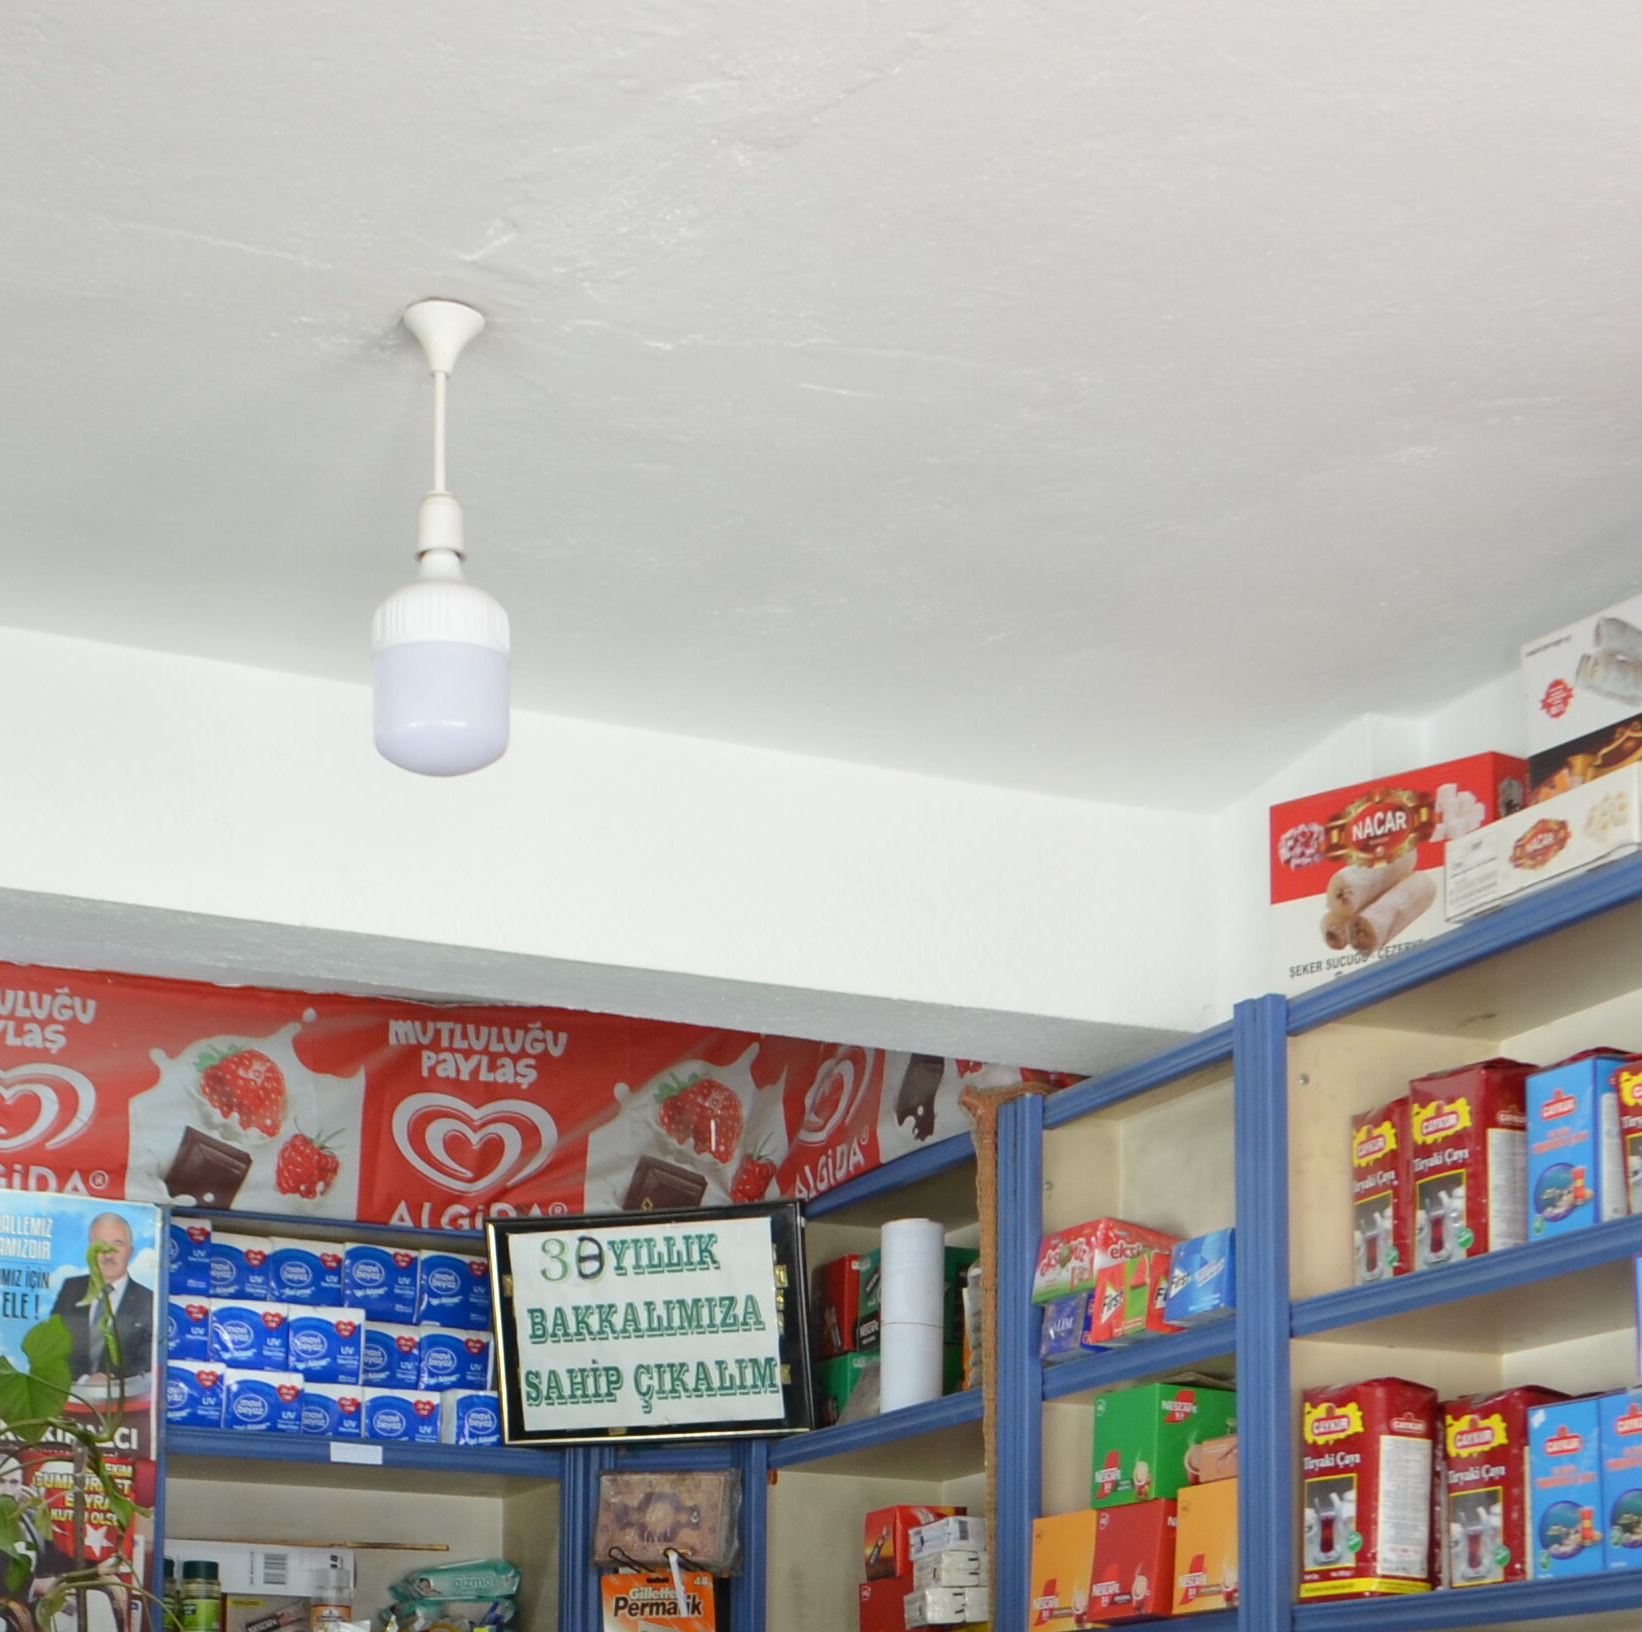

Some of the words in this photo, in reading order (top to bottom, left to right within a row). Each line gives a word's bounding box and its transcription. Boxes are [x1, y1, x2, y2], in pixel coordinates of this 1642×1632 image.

[1352, 809, 1408, 843] NACAR
[2, 1291, 28, 1319] ELE
[526, 1294, 766, 1345] BAKKALIMIZA
[523, 1358, 627, 1408] SAHİP
[635, 1357, 782, 1415] ÇIKALIM
[614, 1596, 705, 1619] Permaik
